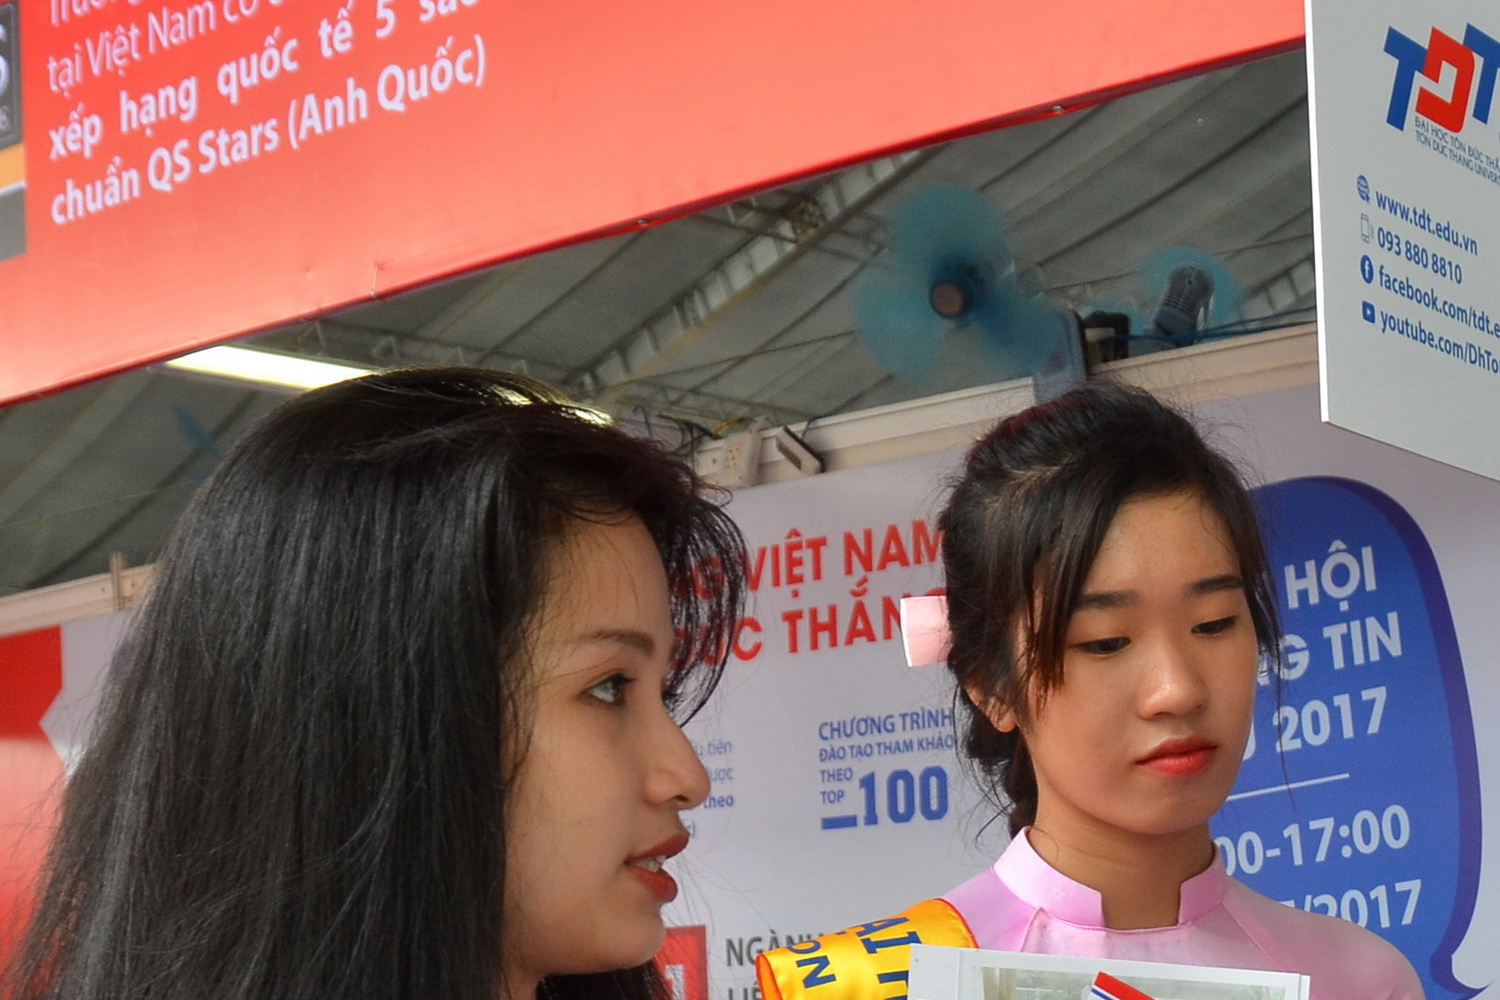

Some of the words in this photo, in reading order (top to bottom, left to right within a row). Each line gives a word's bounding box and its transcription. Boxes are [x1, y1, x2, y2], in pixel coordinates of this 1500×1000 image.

[48, 43, 83, 98] tại
[86, 23, 140, 76] Việt
[148, 0, 216, 54] Nam
[49, 102, 102, 159] xếp
[119, 76, 198, 136] hạng
[216, 26, 299, 104] quốc
[375, 0, 396, 38] 5
[51, 155, 139, 224] chuẩn
[147, 139, 192, 192] QS
[198, 118, 279, 173] Stars
[288, 77, 368, 150] (Anh
[376, 33, 486, 112] Quốc)
[1375, 190, 1478, 256] www.tdt.edu.vn
[1377, 226, 1401, 256] 093
[1405, 240, 1428, 269] 880
[1431, 253, 1463, 285] 8810
[743, 528, 828, 600] VIỆT
[843, 518, 946, 577] NAM
[1284, 539, 1377, 612] HỘI
[781, 575, 947, 654] THẮN
[1323, 610, 1403, 671] TIN
[818, 714, 896, 742] CHƯƠNG
[899, 706, 953, 733] TRÌNH
[818, 744, 847, 763] ĐÀO
[849, 742, 873, 764] TẠO
[875, 738, 914, 757] THAM
[1273, 686, 1387, 753] 2017
[819, 766, 853, 785] THEO
[820, 789, 846, 806] TOP
[858, 765, 949, 826] 100
